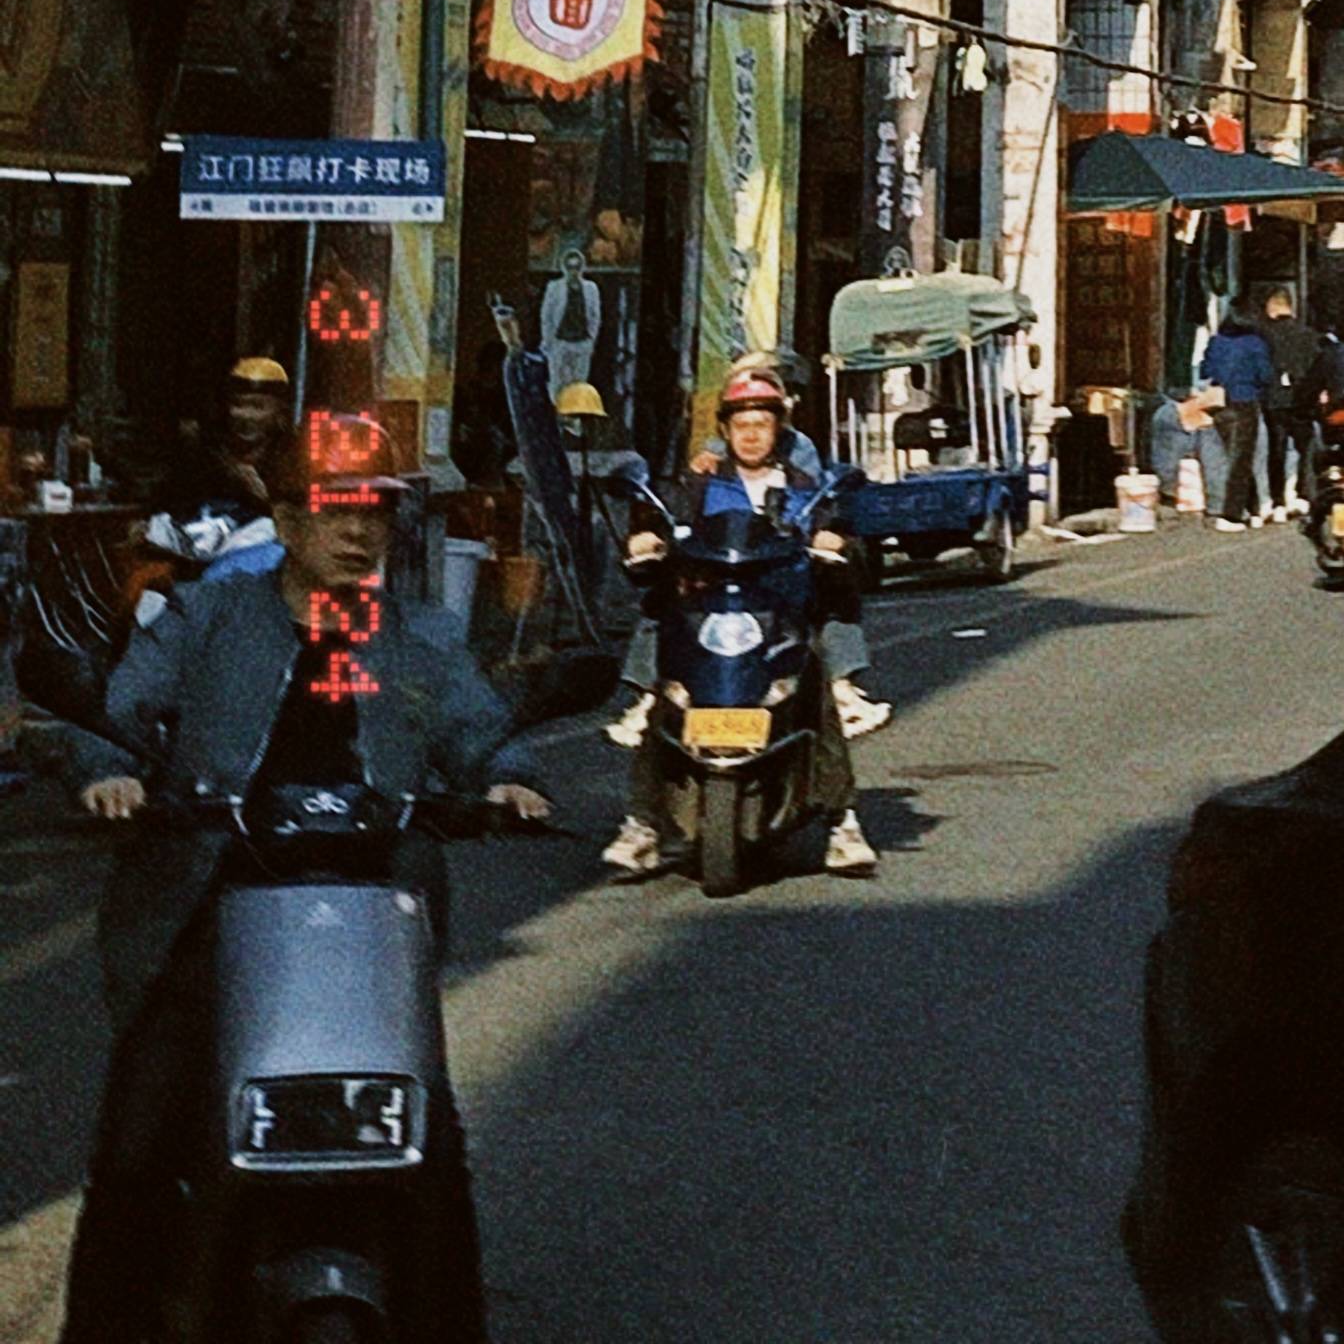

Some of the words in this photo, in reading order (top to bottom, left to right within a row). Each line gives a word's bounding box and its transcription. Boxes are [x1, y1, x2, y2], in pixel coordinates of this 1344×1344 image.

[199, 154, 431, 185] 江门狂飙打卡现场
